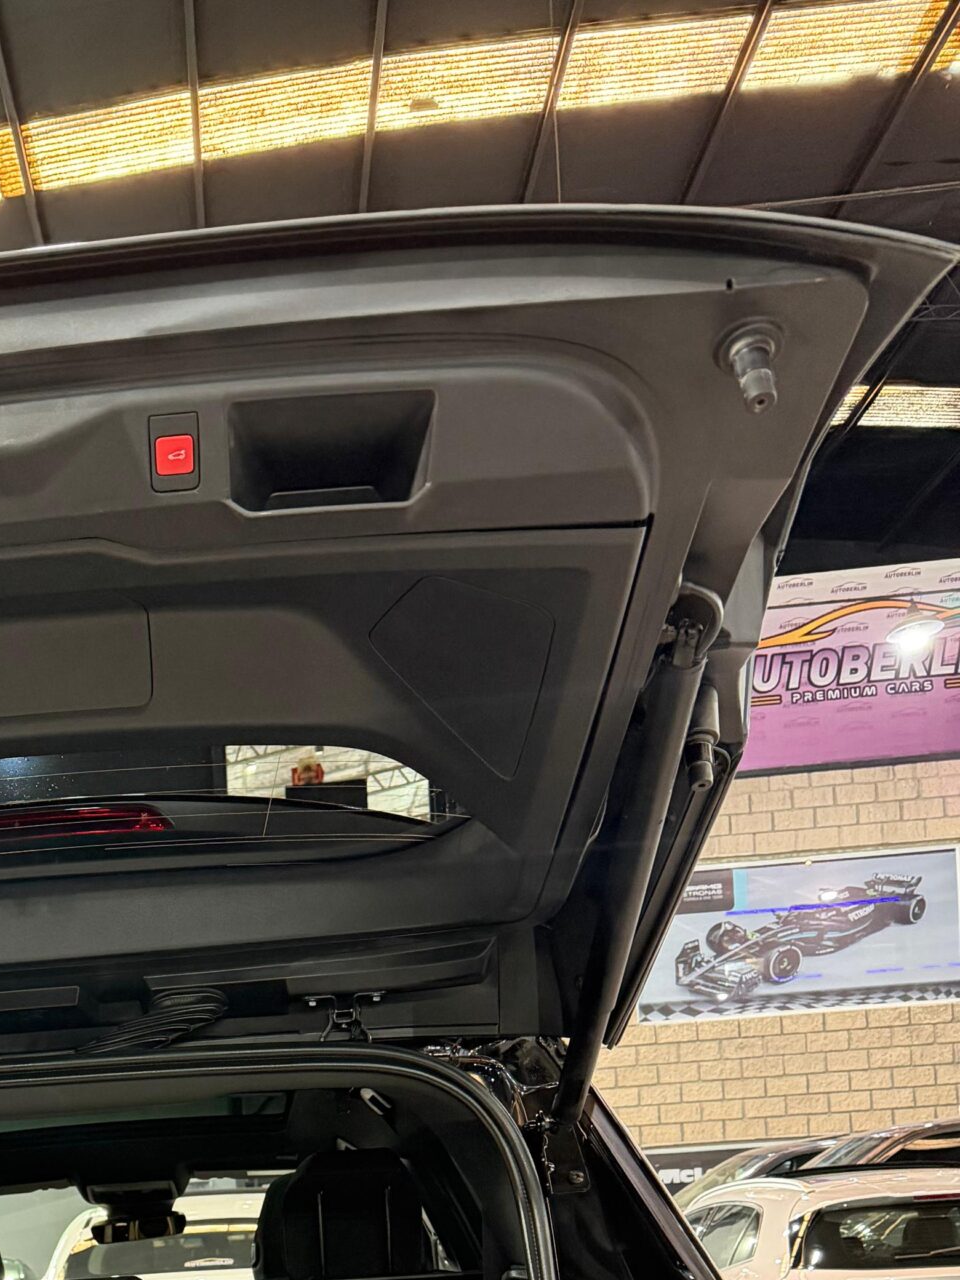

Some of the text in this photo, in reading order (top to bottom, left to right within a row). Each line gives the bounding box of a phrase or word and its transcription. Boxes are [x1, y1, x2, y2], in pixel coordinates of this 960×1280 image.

[752, 637, 960, 693] UTOBERL
[791, 679, 934, 704] PREMIUM CARS
